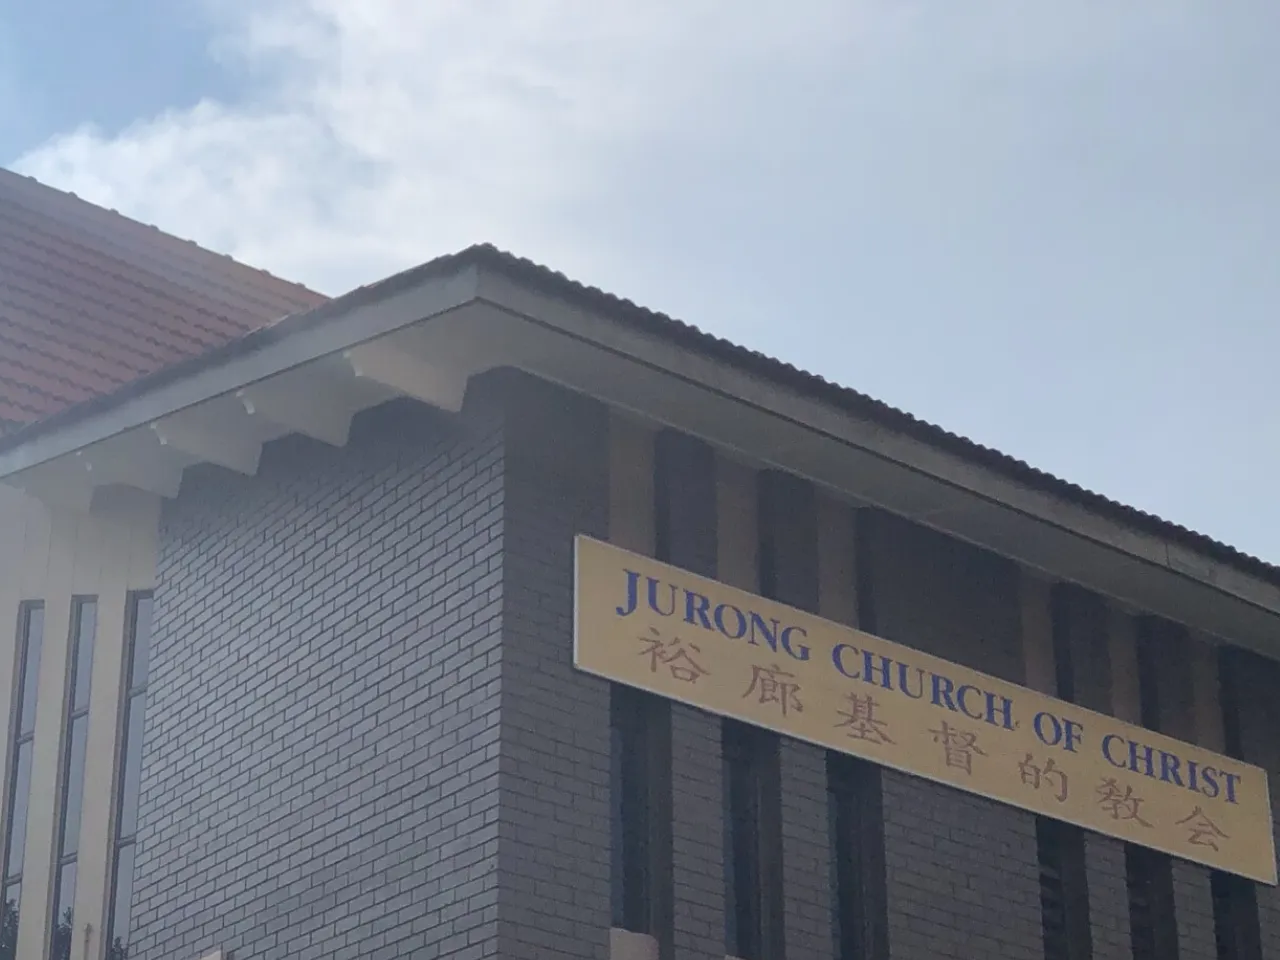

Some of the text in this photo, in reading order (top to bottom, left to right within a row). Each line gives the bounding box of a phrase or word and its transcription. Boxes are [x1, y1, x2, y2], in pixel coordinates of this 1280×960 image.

[615, 567, 1242, 805] JURONG CHURCH OF CHRIST
